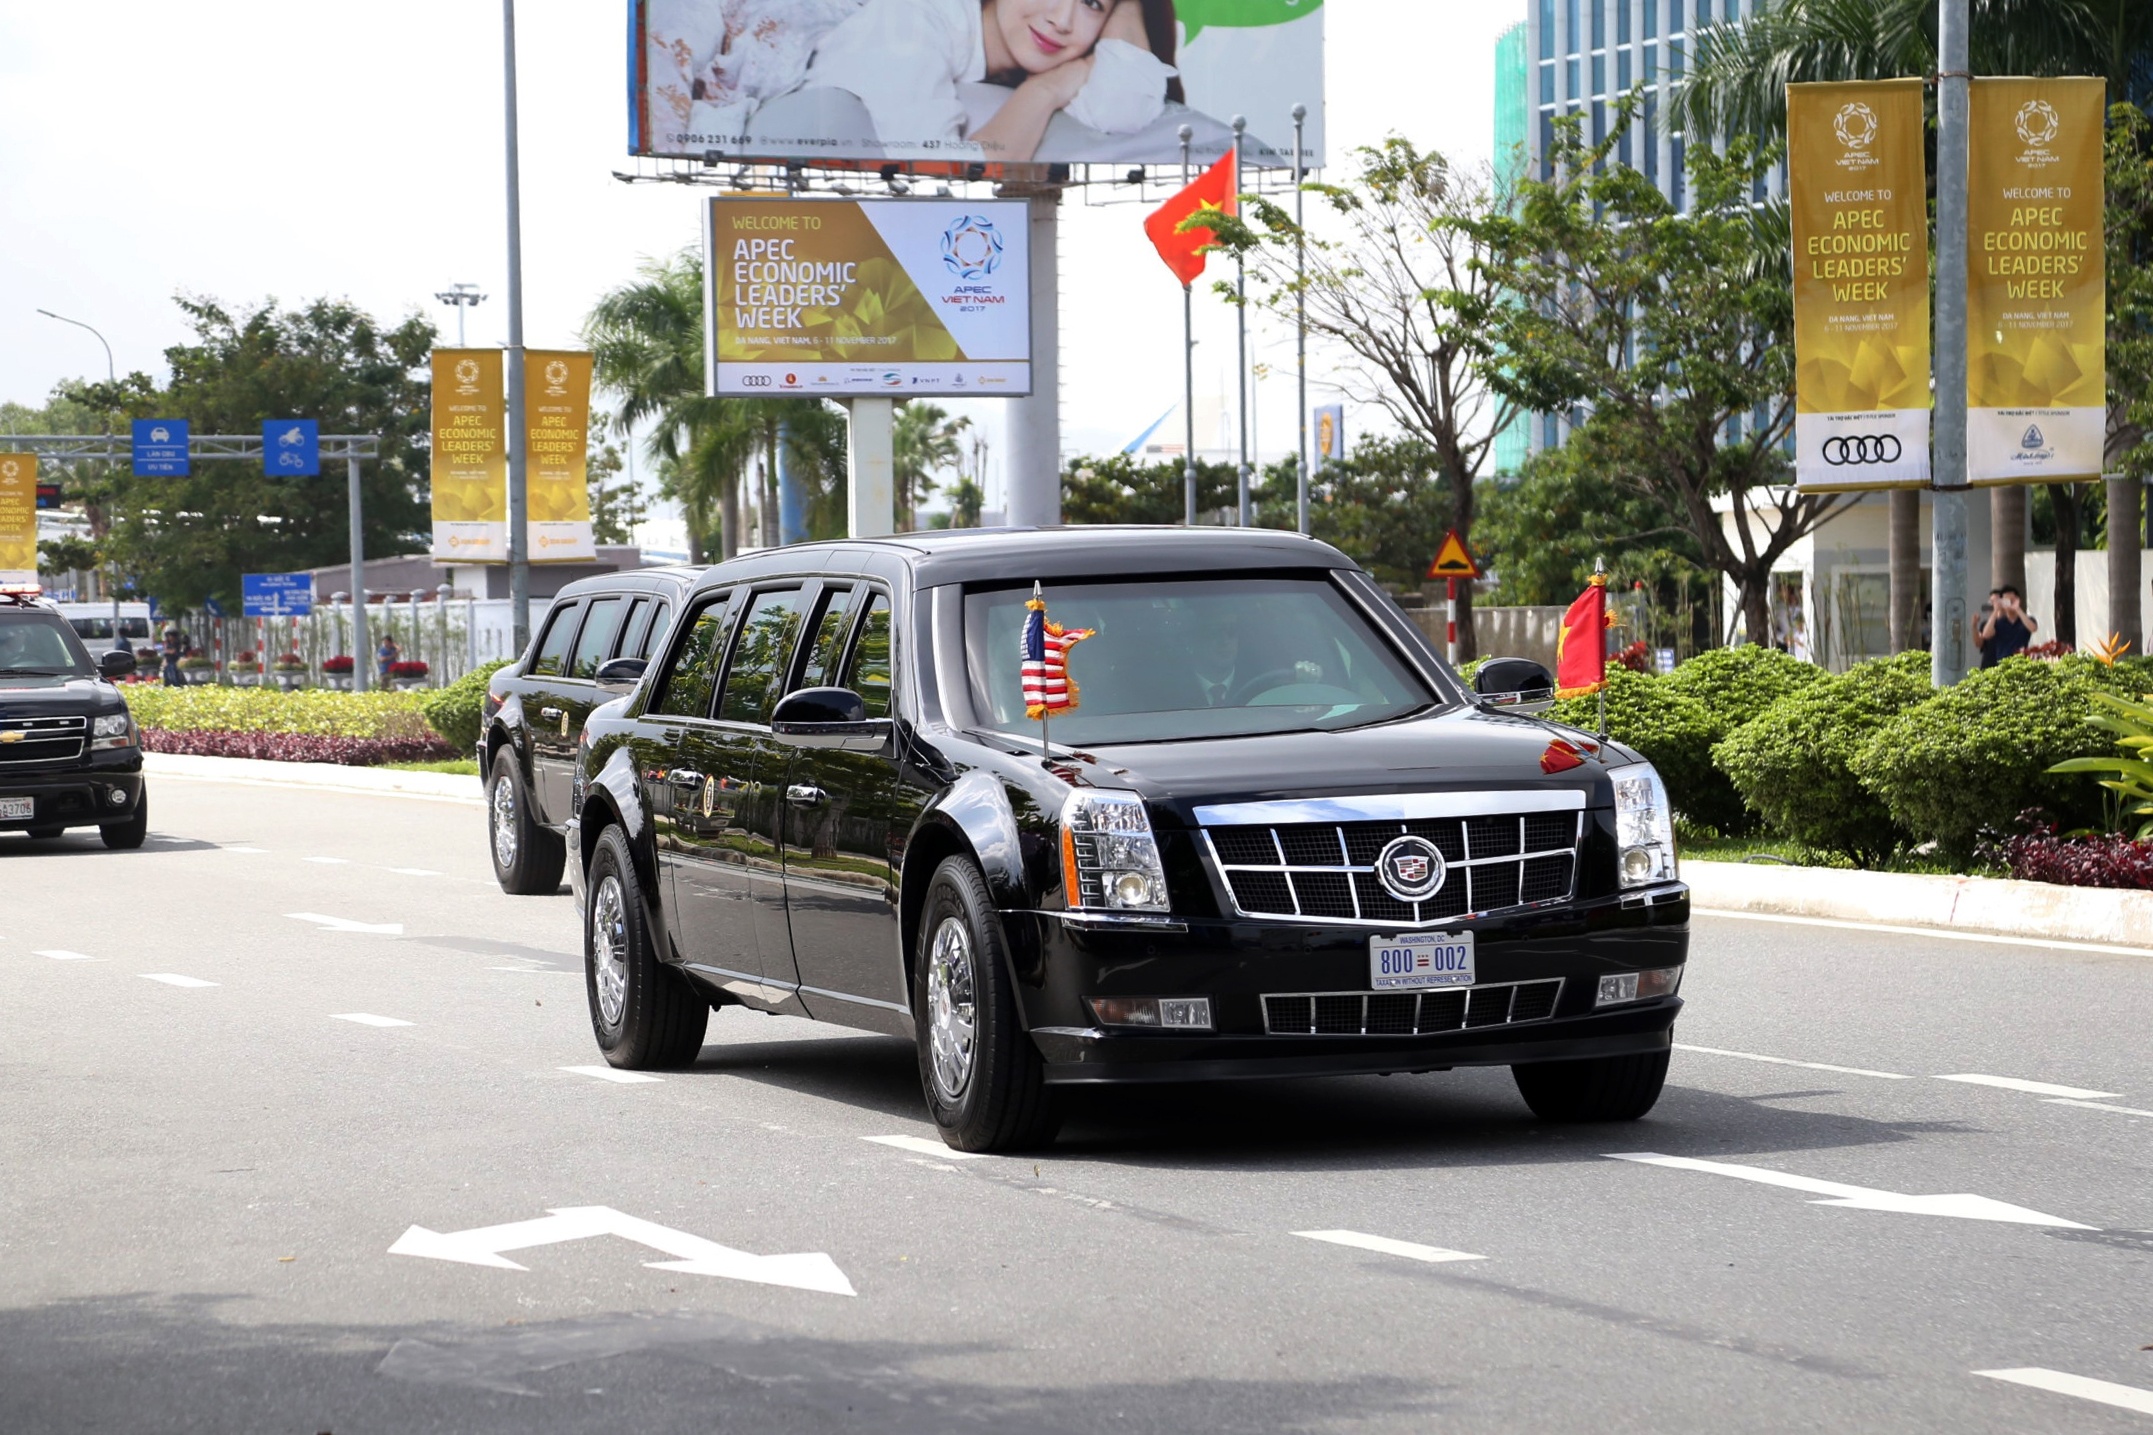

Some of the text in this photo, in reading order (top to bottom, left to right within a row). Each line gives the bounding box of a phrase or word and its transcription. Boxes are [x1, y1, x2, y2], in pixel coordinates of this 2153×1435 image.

[677, 133, 704, 143] 0906
[708, 134, 727, 144] 231
[922, 139, 940, 149] 437
[1824, 189, 1892, 203] WELCOME TO
[2003, 187, 2071, 199] WELCOME TO
[732, 216, 821, 230] WELCOME TO
[1833, 209, 1885, 230] APEC
[2010, 207, 2063, 226] APEC
[1807, 232, 1911, 255] ECONOMIC
[1984, 231, 2087, 251] ECONOMIC
[733, 238, 795, 260] APEC
[734, 262, 856, 283] ECONOMIC
[1832, 281, 1888, 302] WEEK
[2007, 280, 2064, 299] WEEK
[942, 296, 1005, 304] VIET NAM
[735, 307, 802, 328] WEEK
[735, 336, 746, 345] DA
[825, 336, 834, 345] 11
[836, 336, 876, 345] NOVEMBER
[877, 336, 897, 345] 2017
[453, 415, 482, 426] APEC
[541, 416, 567, 427] APEC
[439, 428, 496, 439] ECONOMIC
[530, 429, 579, 440] ECONOMIC
[452, 454, 484, 464] WEEK
[541, 455, 567, 465] WEEK
[1381, 946, 1466, 974] 800 002
[1402, 977, 1425, 985] WITHOUT
